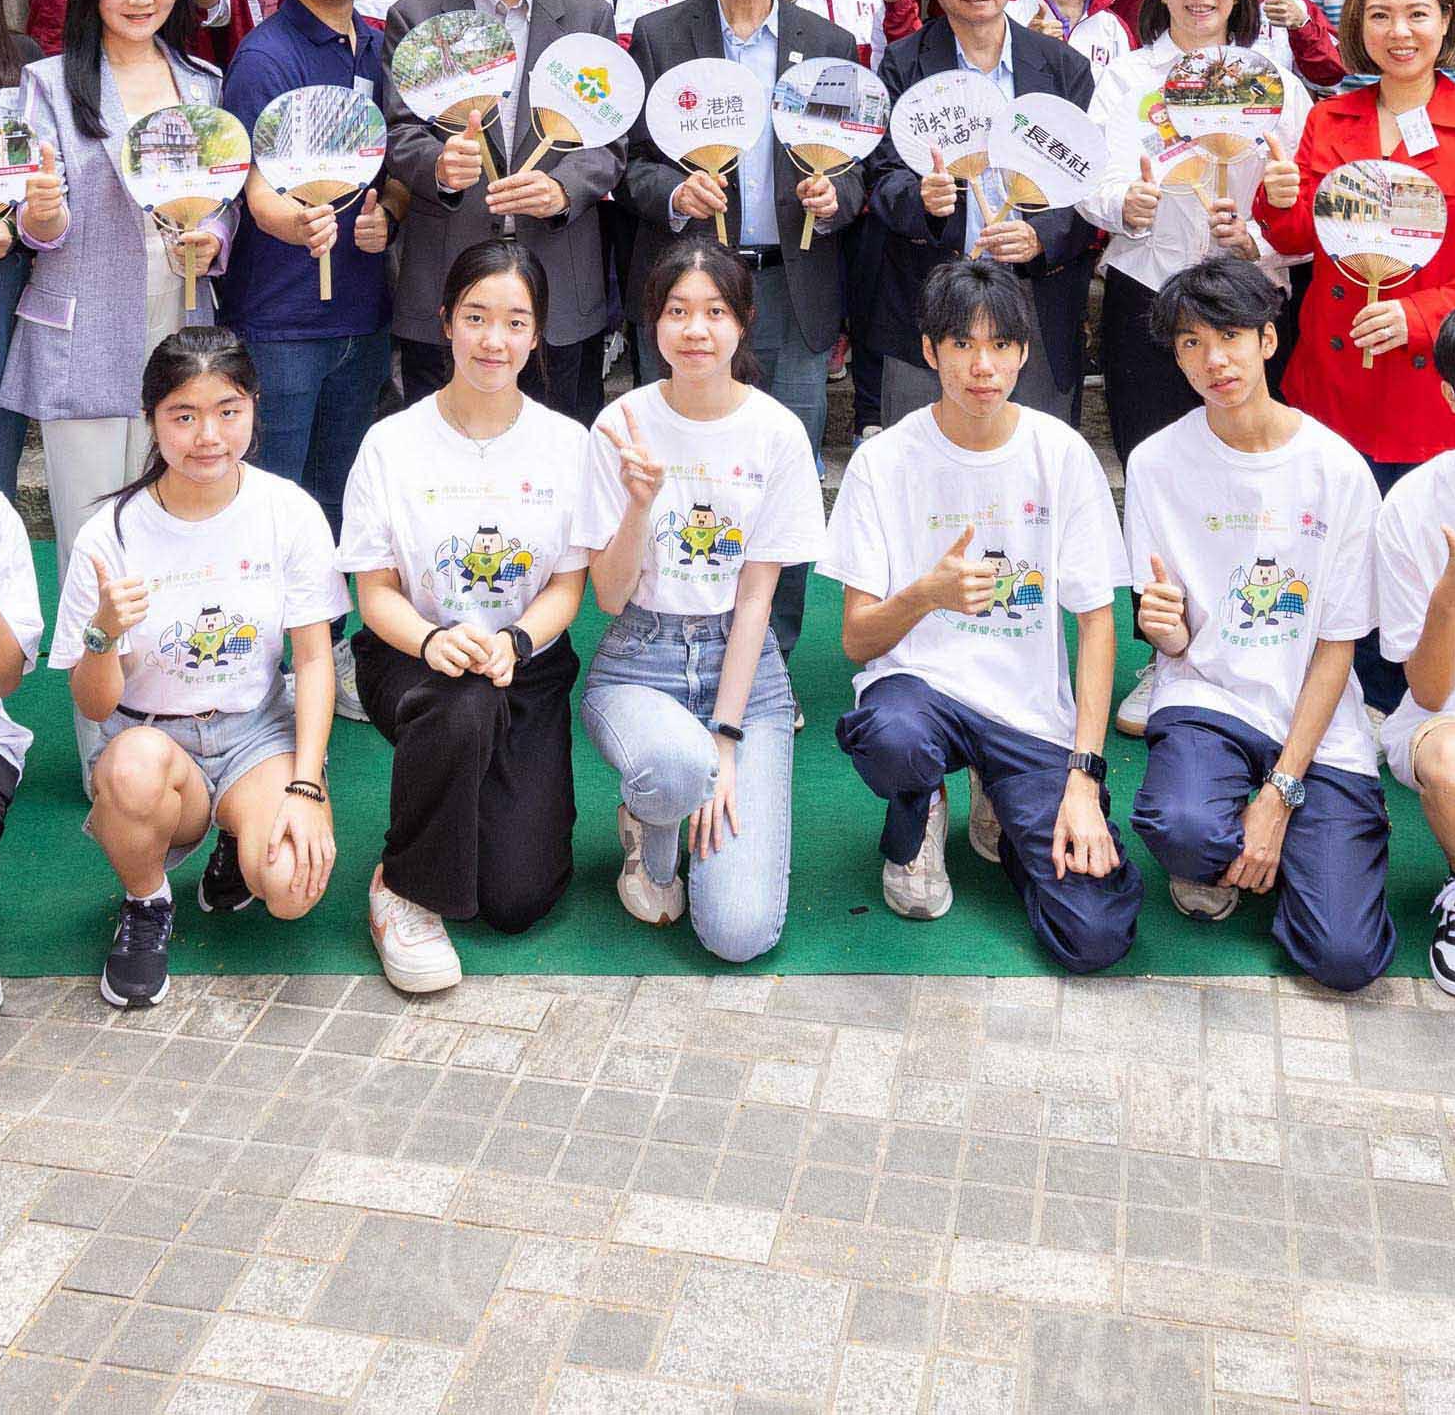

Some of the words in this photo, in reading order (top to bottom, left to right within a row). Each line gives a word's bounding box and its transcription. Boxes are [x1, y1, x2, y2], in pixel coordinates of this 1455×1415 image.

[706, 95, 745, 115] 港燈
[679, 118, 699, 133] HK
[701, 115, 746, 130] Electric
[1024, 123, 1092, 179] 長春社
